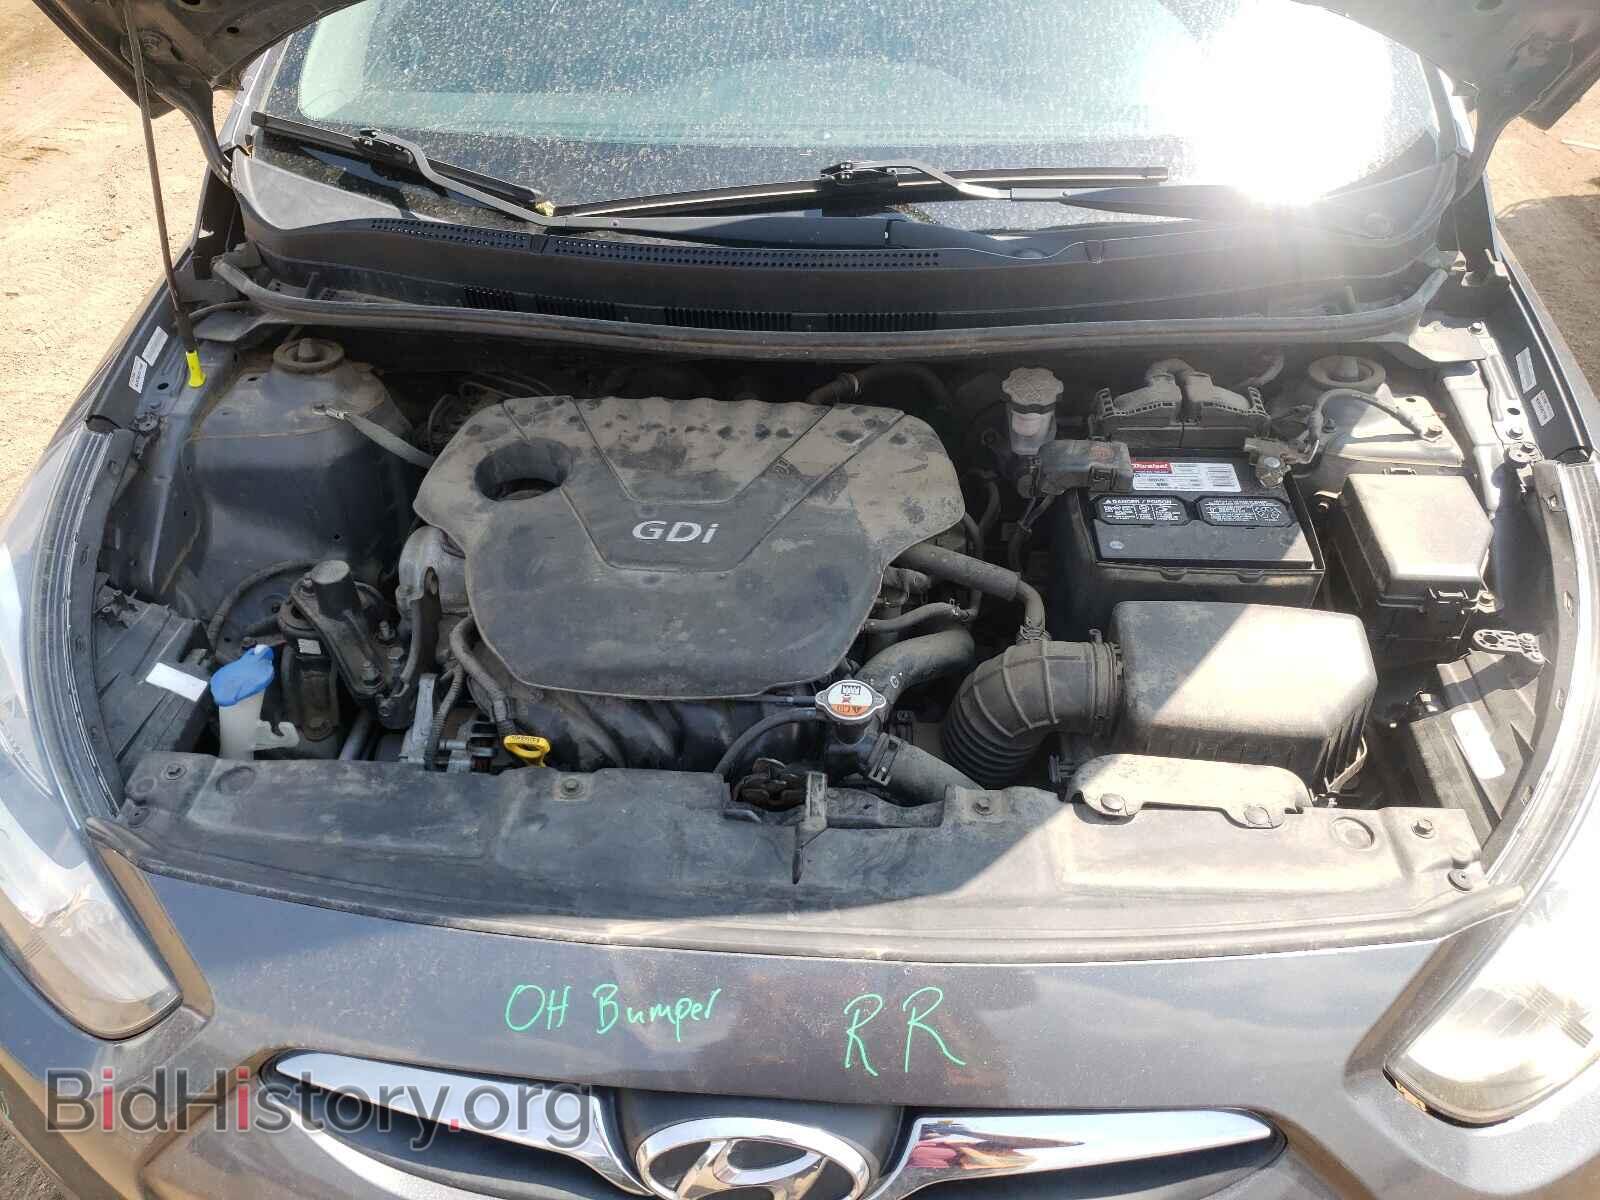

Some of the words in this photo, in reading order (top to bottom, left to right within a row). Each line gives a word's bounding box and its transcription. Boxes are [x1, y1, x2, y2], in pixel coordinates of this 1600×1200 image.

[631, 520, 720, 543] GDi
[504, 983, 573, 1032] OH
[591, 982, 723, 1043] Bumper
